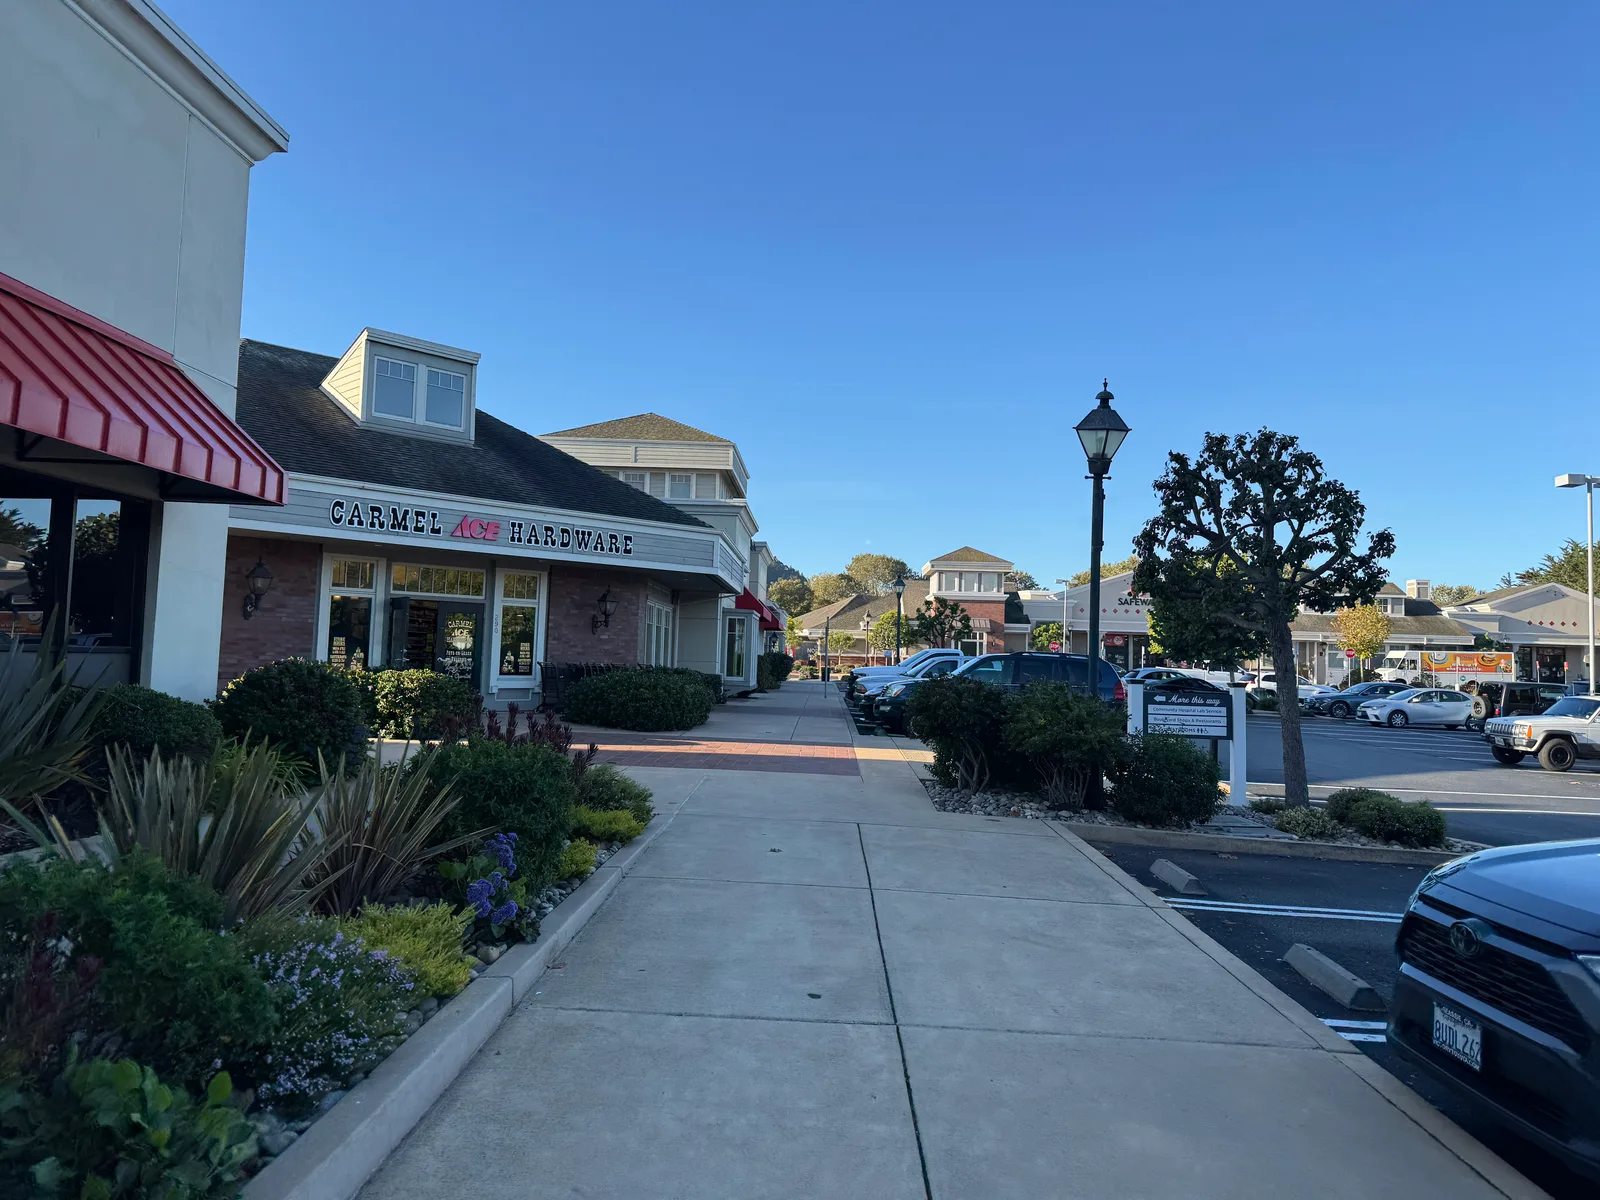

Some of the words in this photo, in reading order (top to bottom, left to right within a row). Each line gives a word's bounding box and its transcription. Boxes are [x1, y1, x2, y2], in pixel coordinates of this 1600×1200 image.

[330, 499, 442, 535] CARMEL
[451, 514, 501, 541] ACE
[508, 521, 633, 555] HARDWARE
[1118, 598, 1153, 606] SAFEWA
[1168, 694, 1189, 704] More
[1191, 696, 1204, 704] this
